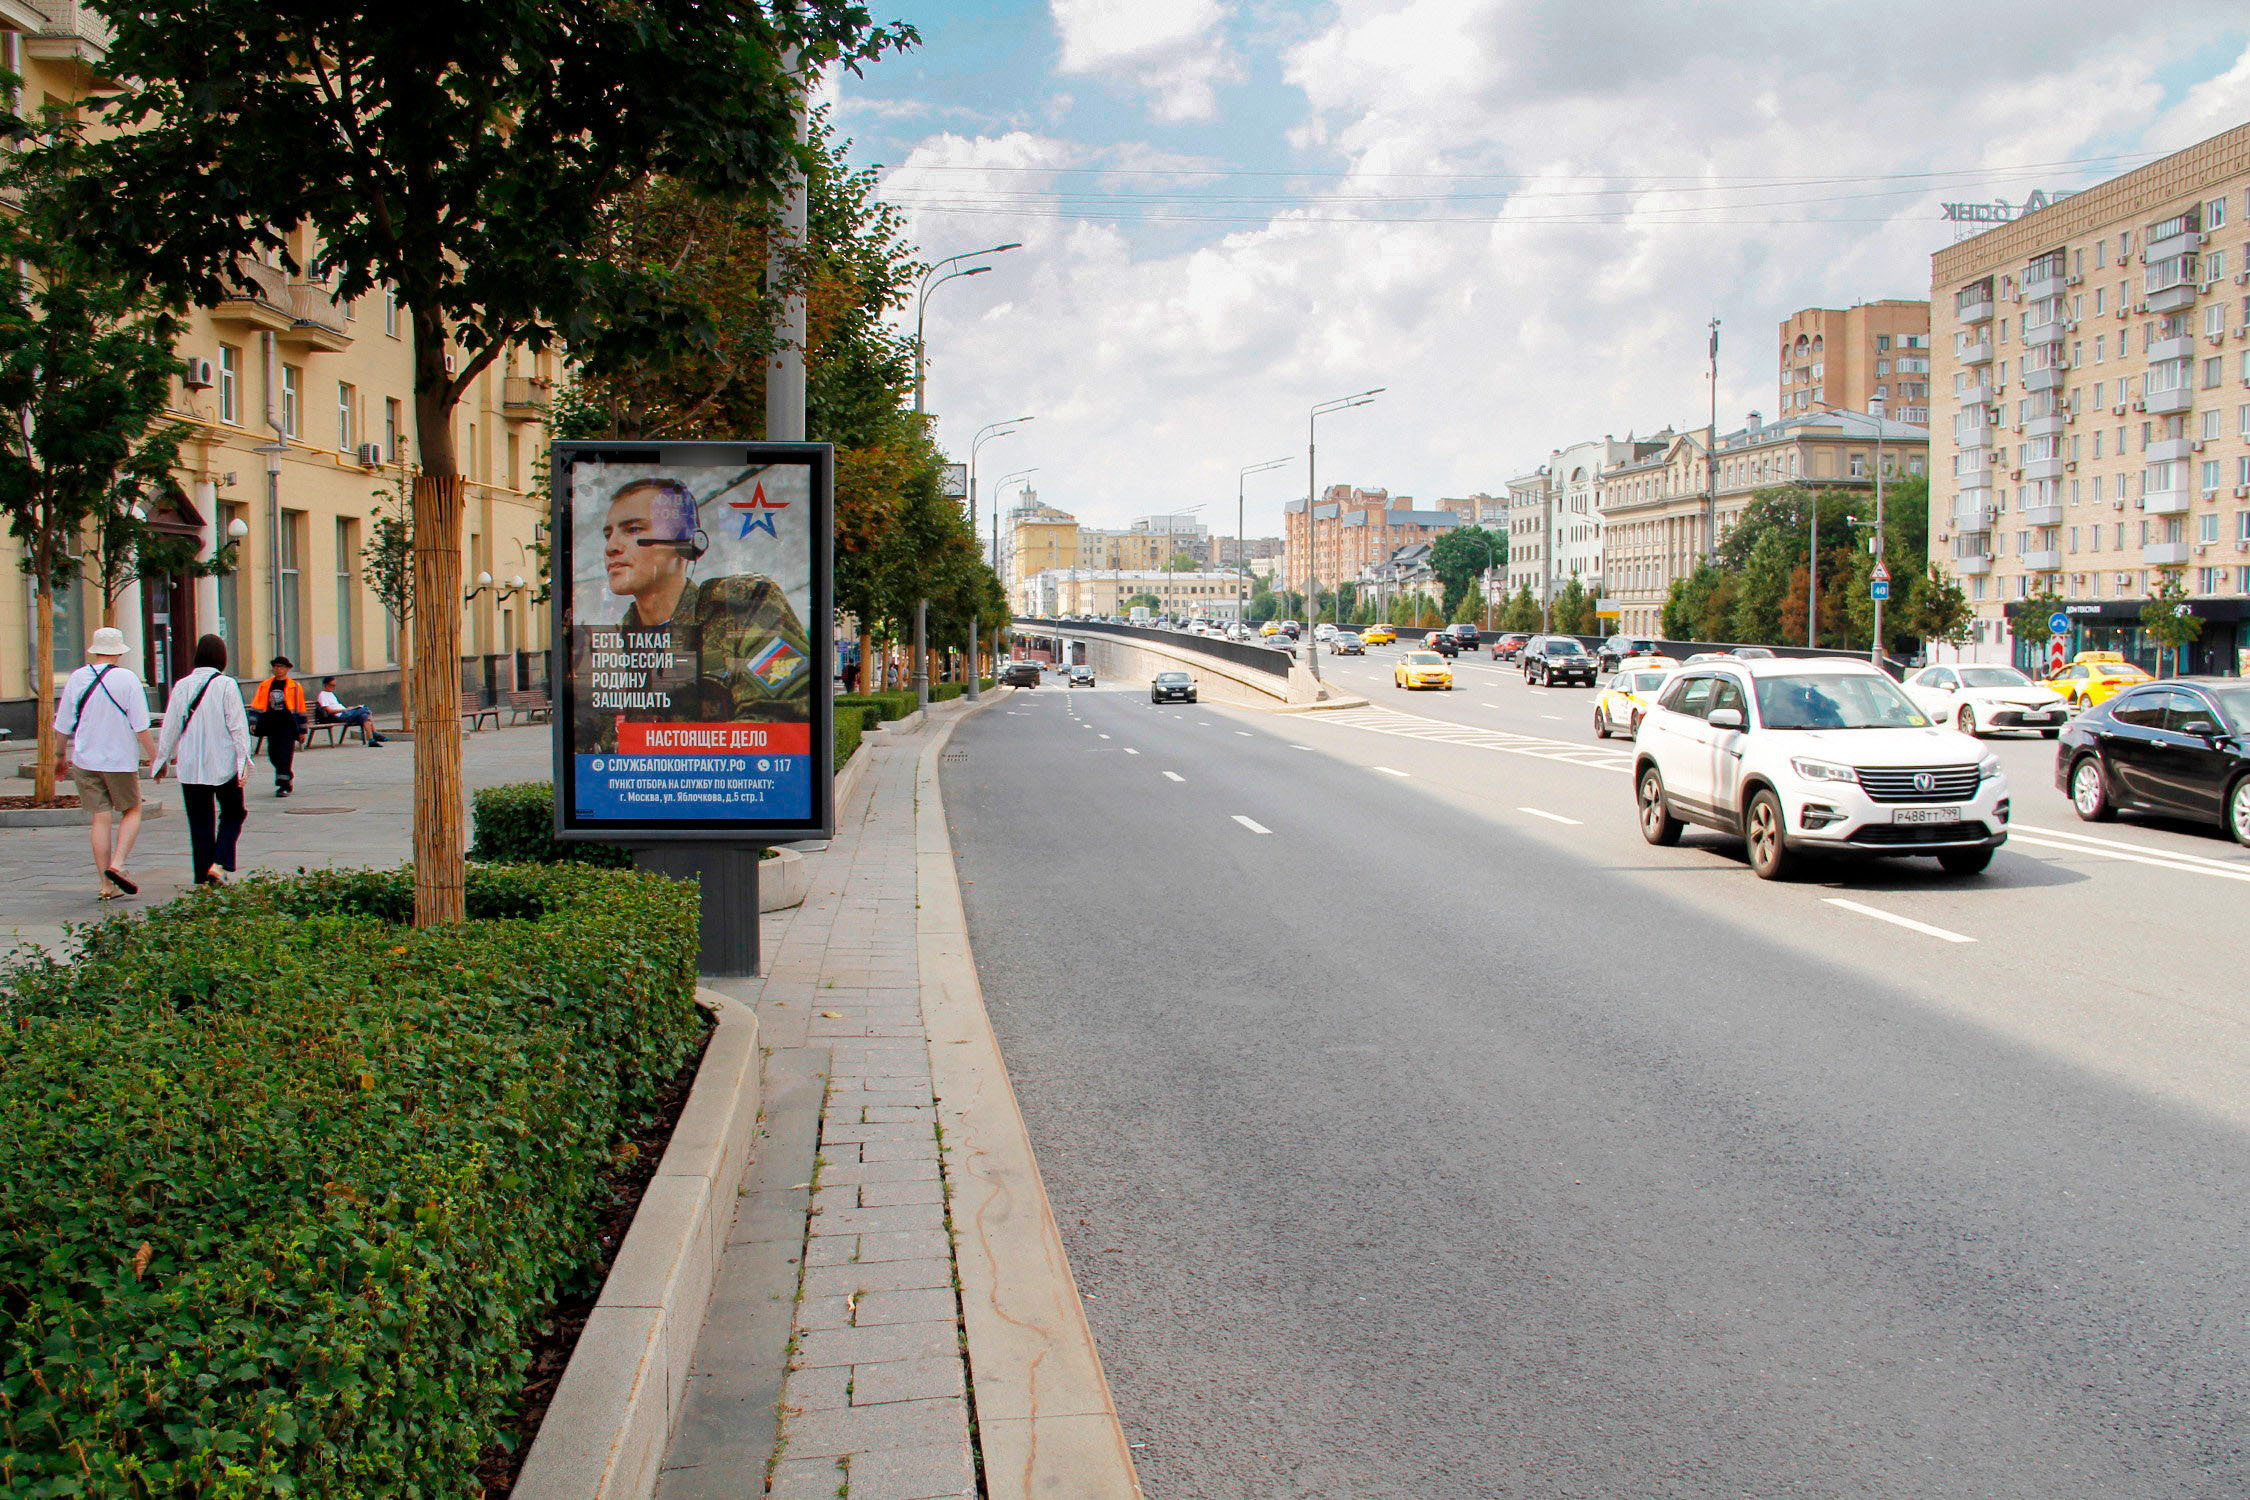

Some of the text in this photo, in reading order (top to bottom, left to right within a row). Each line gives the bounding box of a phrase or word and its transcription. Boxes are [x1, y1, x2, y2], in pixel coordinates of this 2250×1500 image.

[1874, 586, 1886, 595] 40
[592, 633, 671, 649] ЕСТЬ ТАКАЯ
[592, 652, 673, 669] ПРОФЕССИЯ
[592, 672, 647, 690] РОДИНУ
[592, 692, 671, 710] ЗАЩИЩАТЬ
[646, 730, 768, 748] НАСТОЯЩЕЕ ДЕЛО
[608, 759, 792, 772] СЛУЖБАПОКОНТРАКТУ.РФ 117
[609, 779, 775, 790] ПУНКТ ОТБОРА НА СЛУЖБУ ПО КОНТРАКТУ:
[620, 793, 627, 802] г.
[628, 792, 663, 803] Москва,
[663, 794, 676, 803] ул.
[740, 794, 758, 803] стр.
[759, 792, 764, 802] 1
